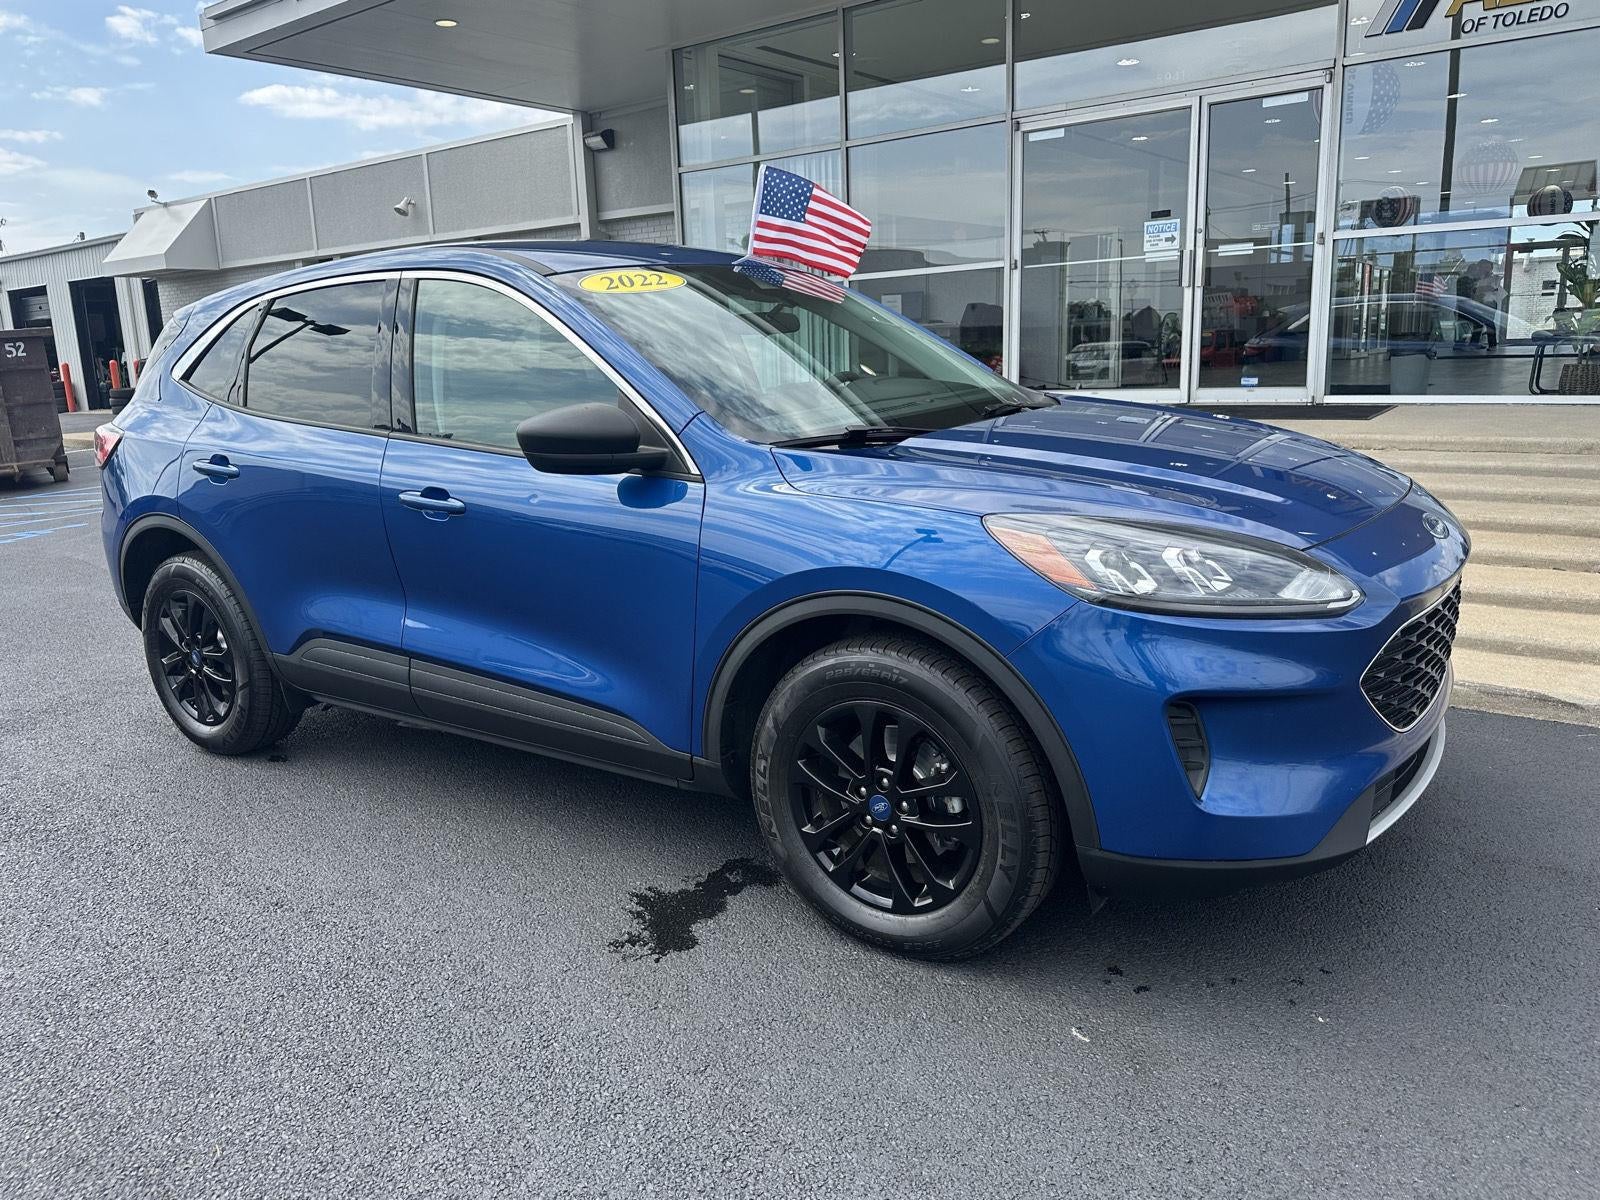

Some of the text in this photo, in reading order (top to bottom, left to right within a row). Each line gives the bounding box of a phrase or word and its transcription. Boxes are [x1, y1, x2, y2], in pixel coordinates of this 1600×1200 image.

[1461, 16, 1487, 34] OF
[1492, 2, 1570, 30] TOLEDO
[1148, 223, 1176, 233] NOTICE
[599, 273, 668, 291] 2022
[4, 341, 27, 358] 52
